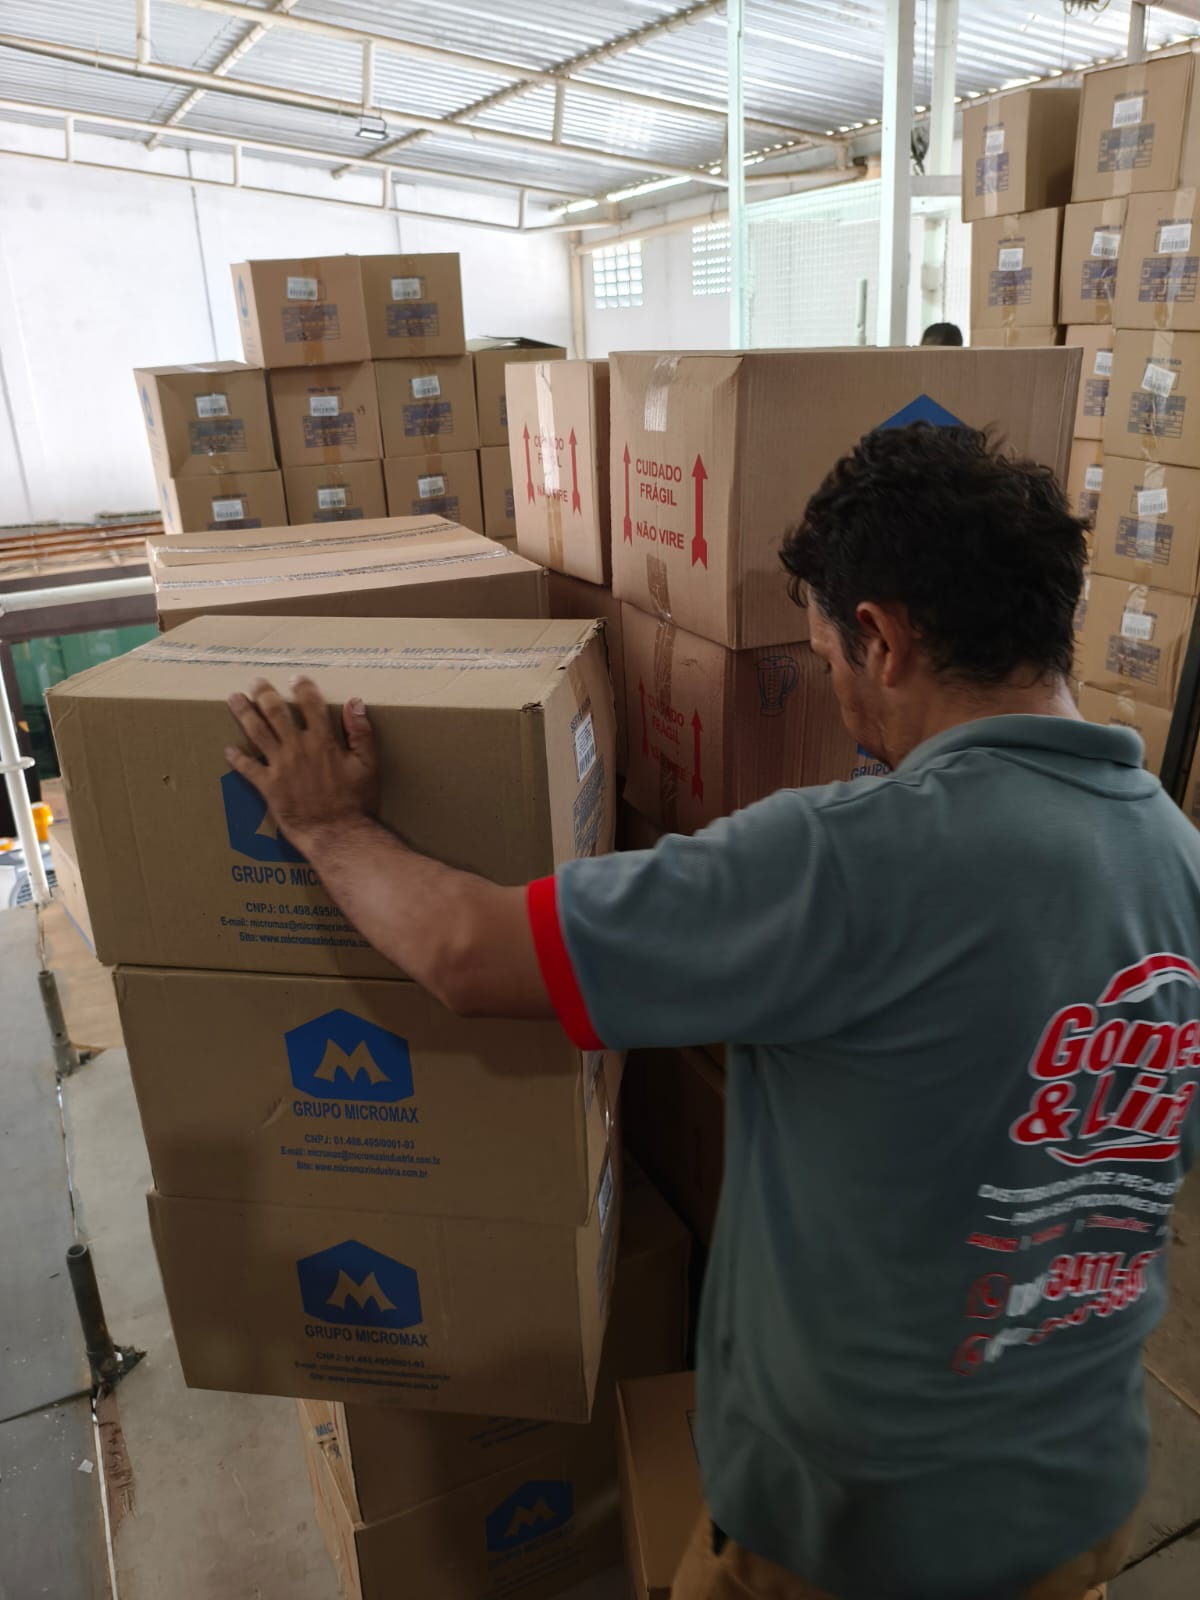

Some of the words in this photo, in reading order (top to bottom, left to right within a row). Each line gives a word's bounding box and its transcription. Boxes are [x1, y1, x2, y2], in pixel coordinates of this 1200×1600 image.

[635, 458, 682, 483] CUIDADO
[640, 483, 677, 506] FRÁGIL
[636, 521, 657, 541] NÃO
[659, 529, 685, 550] VIRE
[204, 644, 297, 656] MICROMAX
[302, 647, 394, 656] MICROMAX
[401, 647, 495, 656] MICROMAX
[231, 864, 286, 884] GRUPO
[290, 867, 320, 886] MIC
[246, 902, 275, 914] CNPJ:
[293, 1101, 342, 1118] GRUPO
[344, 1103, 419, 1124] MICROMAX
[1009, 1080, 1081, 1146] &
[304, 1133, 332, 1145] CNPJ:
[305, 1324, 352, 1341] GRUPO
[355, 1328, 429, 1347] MICROMAX
